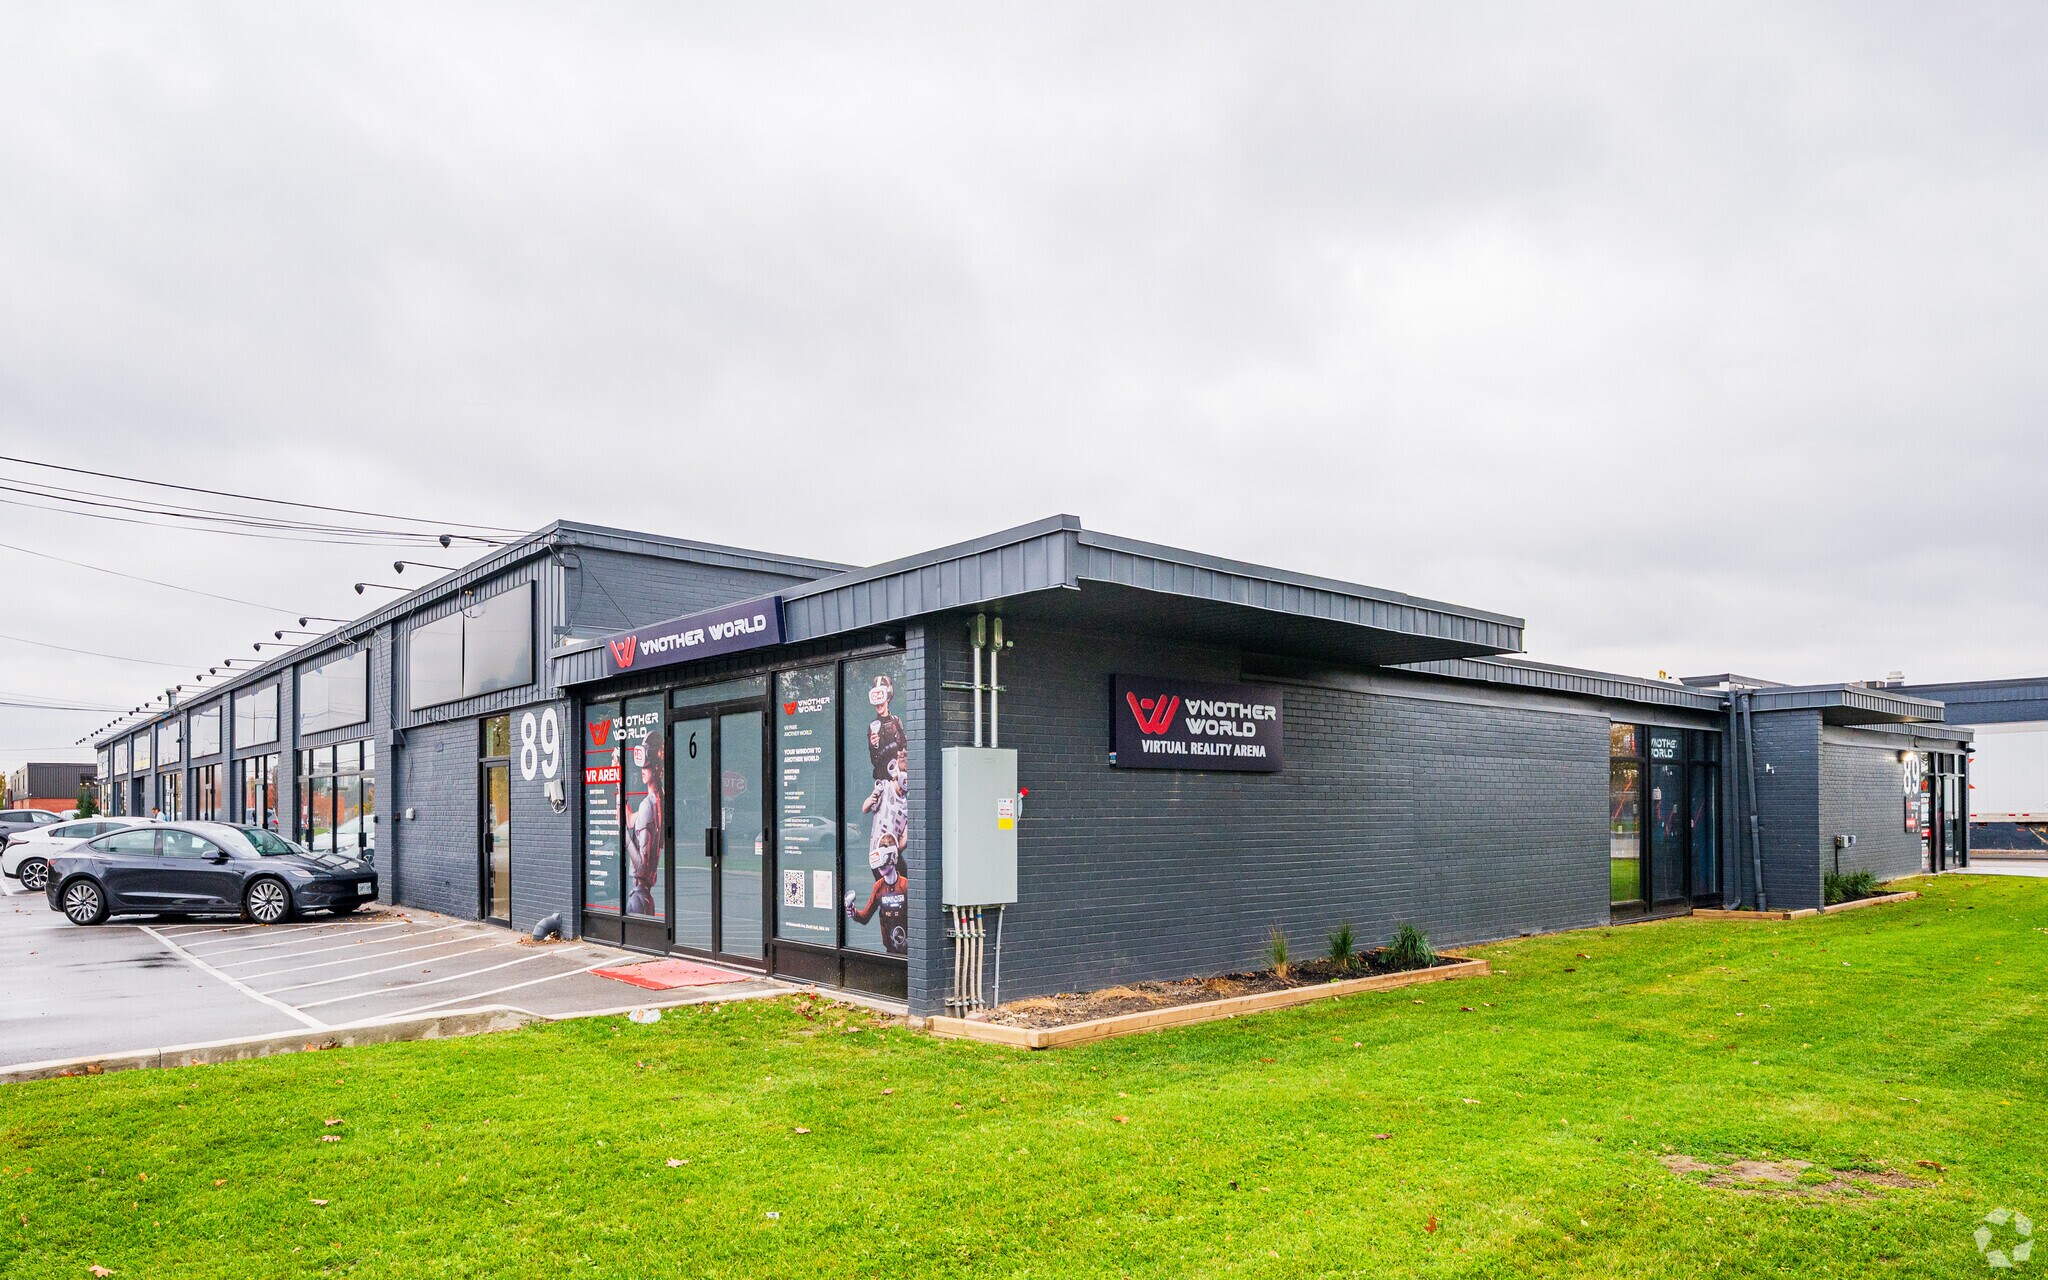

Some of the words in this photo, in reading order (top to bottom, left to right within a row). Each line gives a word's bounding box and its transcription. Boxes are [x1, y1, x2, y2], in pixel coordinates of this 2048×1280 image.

[640, 628, 705, 656] ANOTHER
[708, 614, 767, 641] WORLD
[797, 696, 831, 707] ANOTHER
[797, 704, 823, 713] WORLD
[1185, 698, 1277, 721] ANOTHER
[612, 712, 659, 729] AOTHER
[1185, 717, 1257, 738] WORLD
[612, 726, 648, 741] WORLD
[520, 707, 560, 781] 89
[689, 731, 697, 759] 6
[815, 746, 822, 754] TO
[1141, 739, 1189, 755] VIRTUAL
[1190, 742, 1233, 757] REALITY
[1233, 744, 1267, 758] ARENA
[1651, 738, 1678, 749] NOTHE
[586, 769, 597, 783] VR
[598, 768, 621, 782] AREN
[1903, 754, 1920, 795] 89
